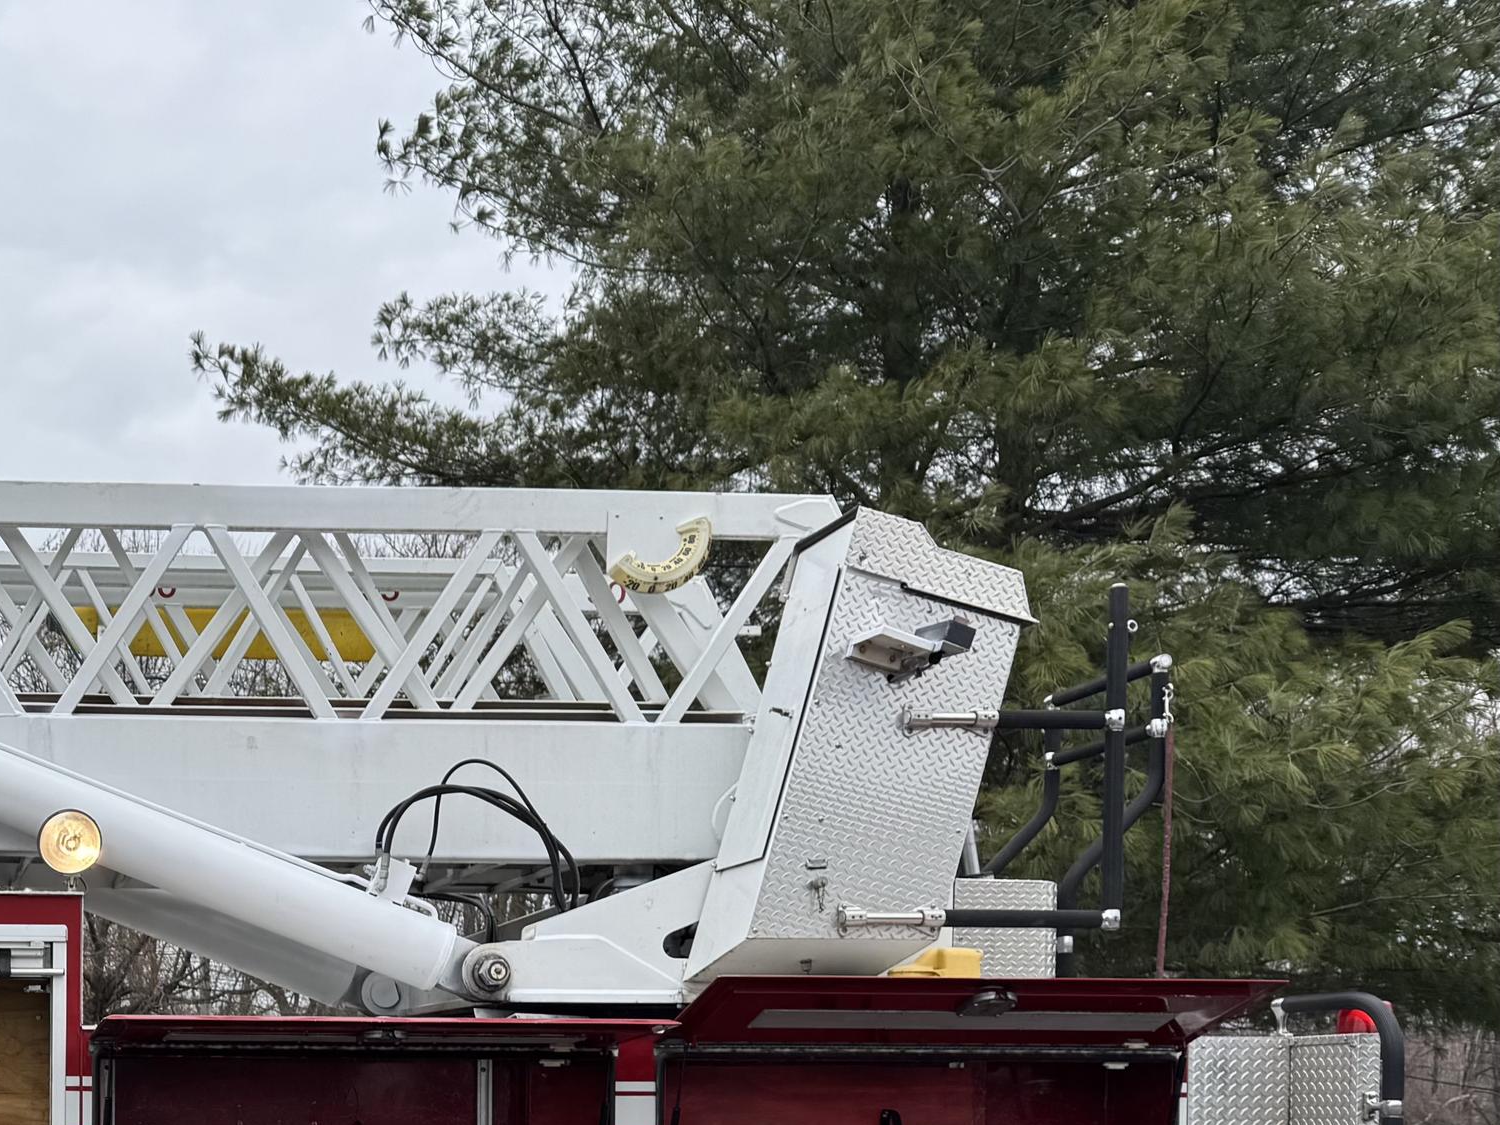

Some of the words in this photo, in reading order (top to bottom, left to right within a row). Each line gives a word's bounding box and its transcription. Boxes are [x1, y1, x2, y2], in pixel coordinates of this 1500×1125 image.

[623, 579, 640, 591] -20
[648, 583, 656, 593] 0
[665, 581, 678, 592] 20
